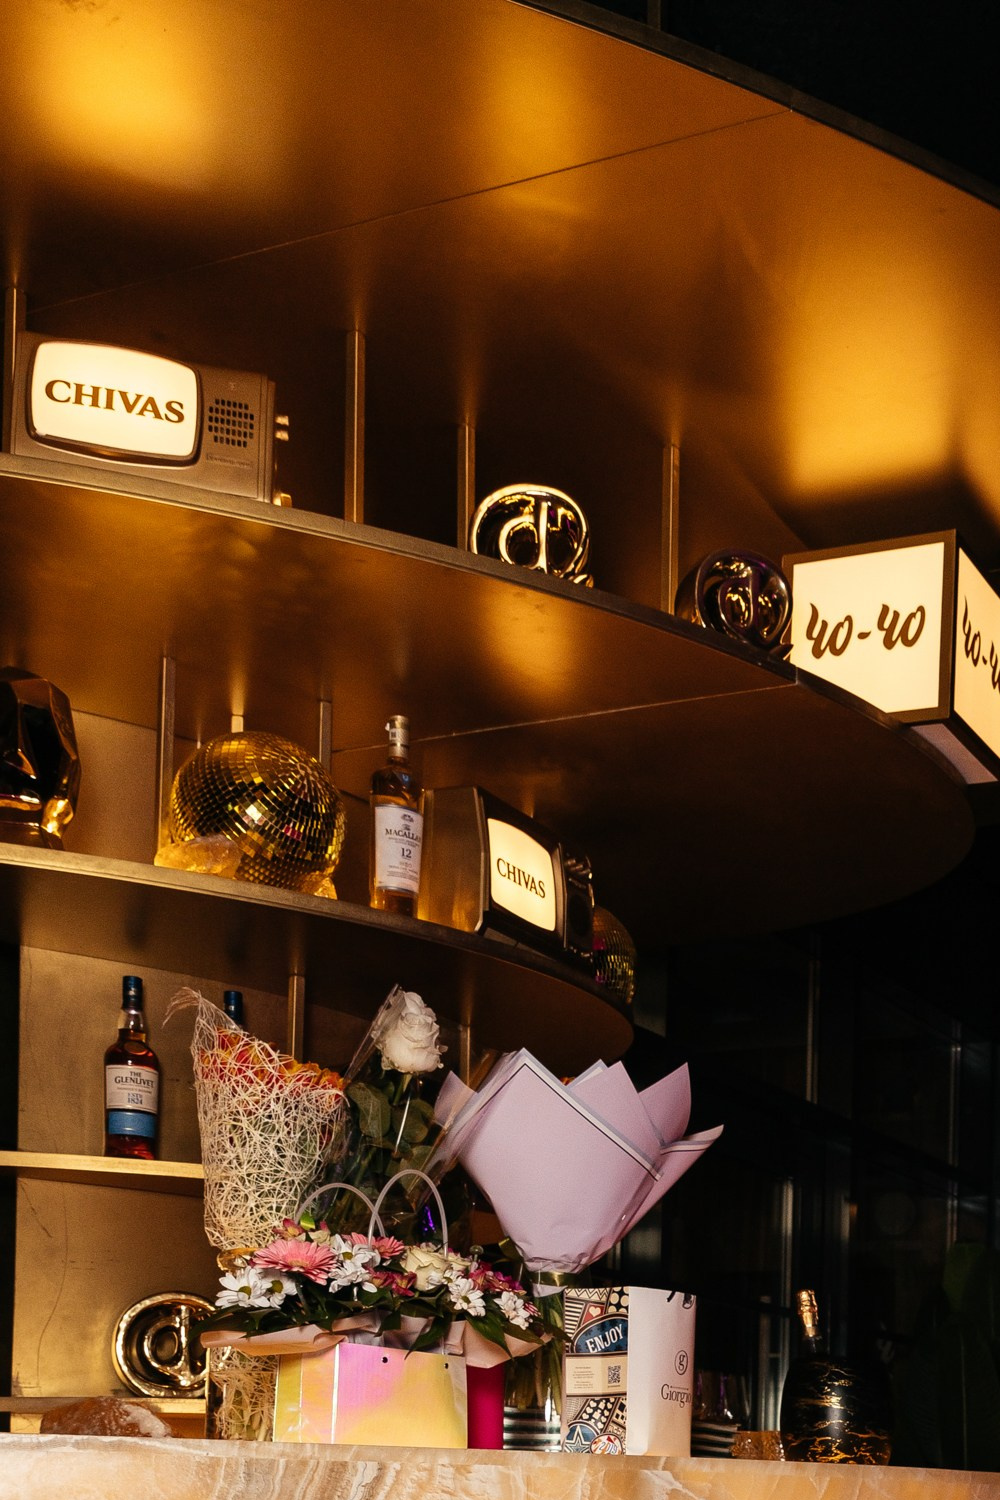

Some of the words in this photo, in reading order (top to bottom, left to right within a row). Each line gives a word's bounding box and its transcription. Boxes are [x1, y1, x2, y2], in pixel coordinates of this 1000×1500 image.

[44, 379, 185, 424] CHIVAS
[805, 602, 926, 660] 40-40
[401, 847, 412, 859] 12
[496, 857, 546, 899] CHIVAS
[114, 1076, 154, 1089] GLENLIVET
[586, 1324, 623, 1353] ENJOY
